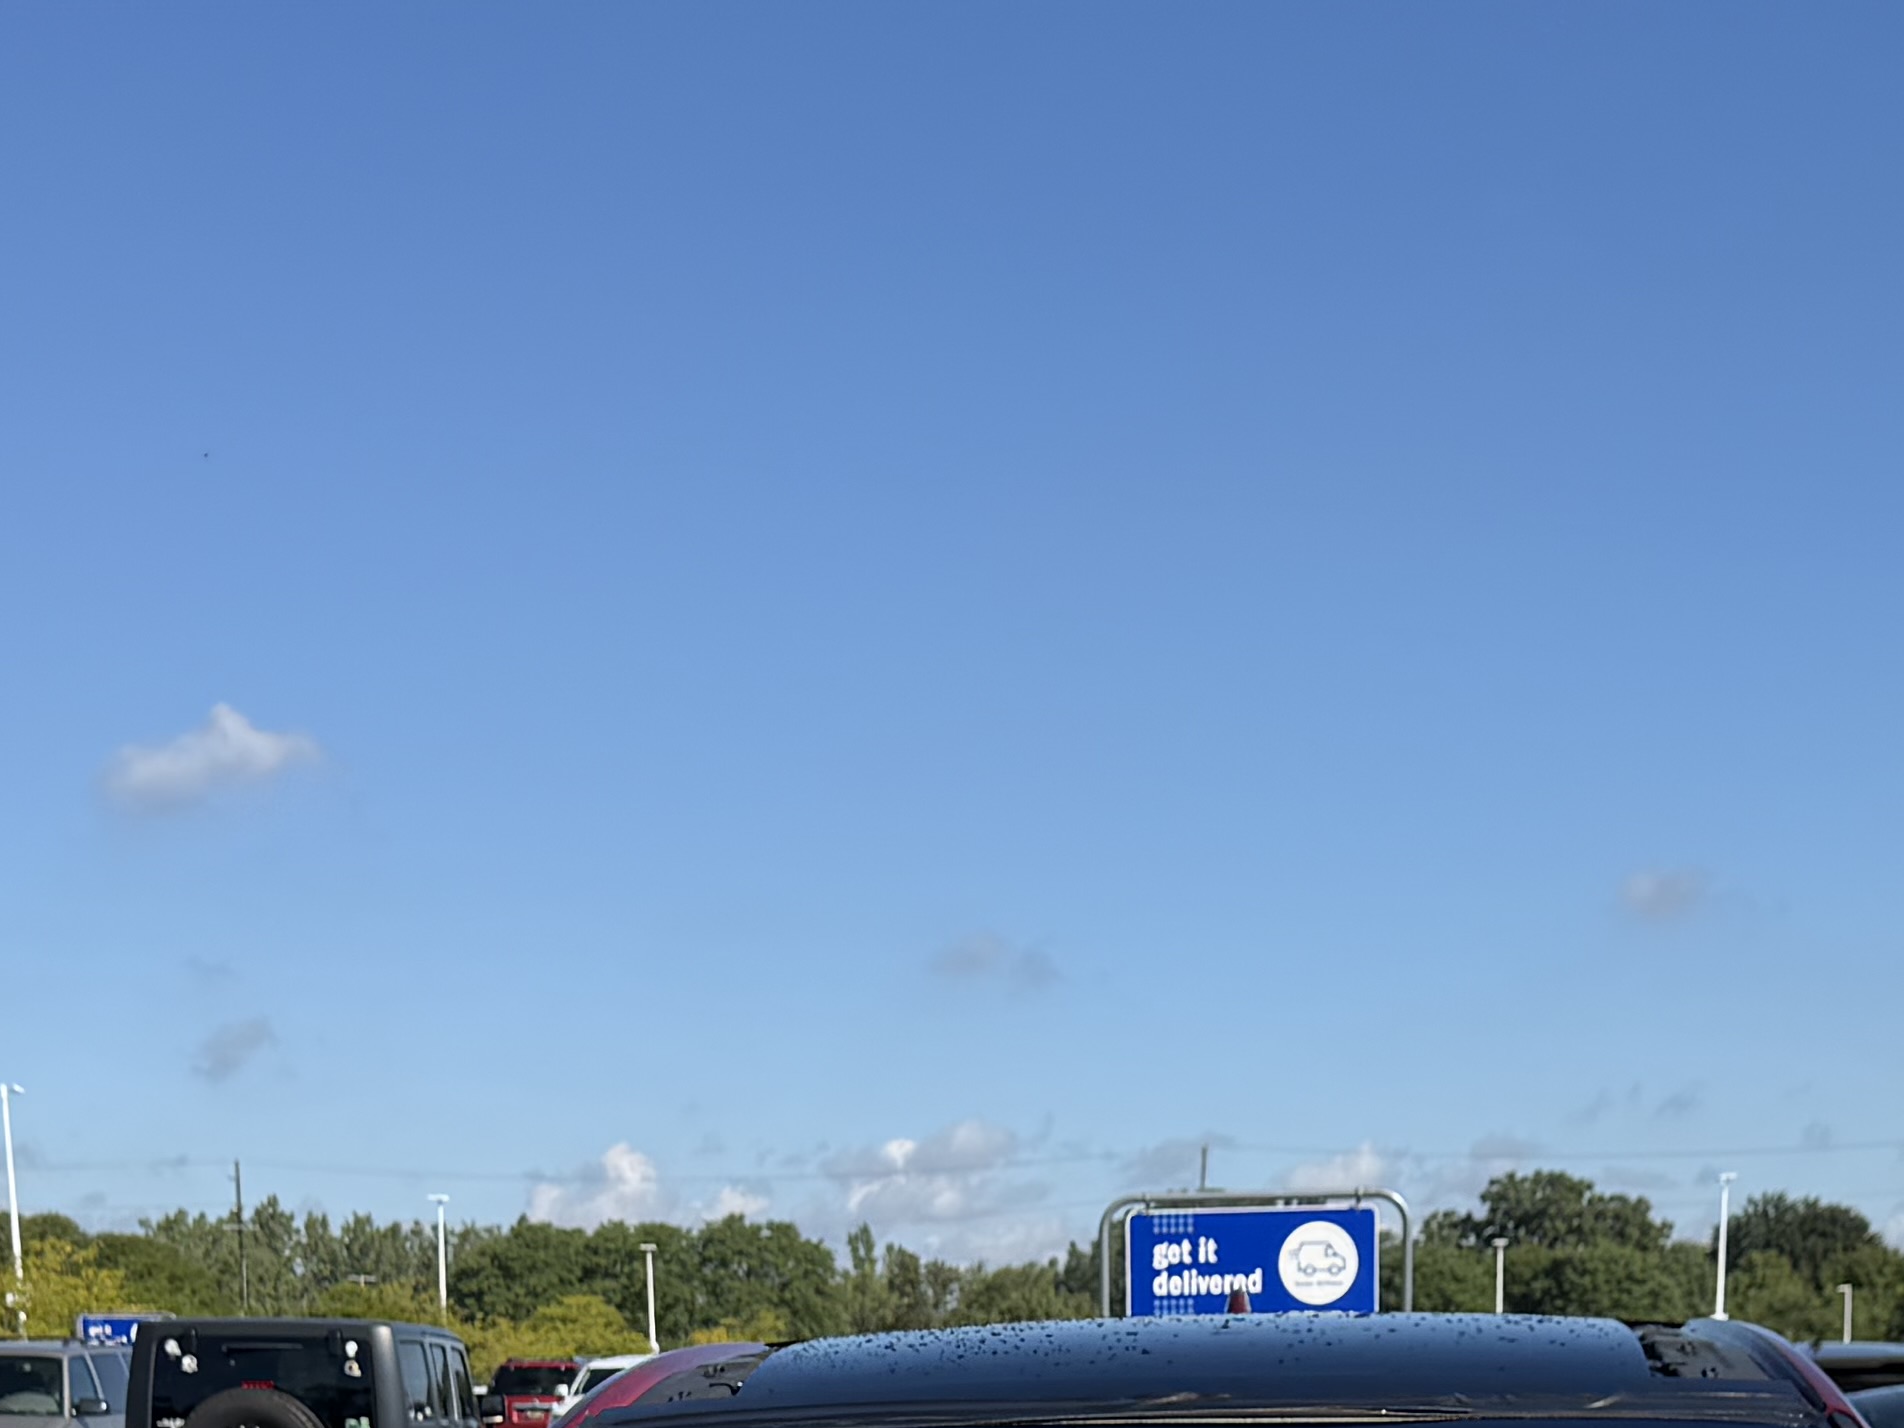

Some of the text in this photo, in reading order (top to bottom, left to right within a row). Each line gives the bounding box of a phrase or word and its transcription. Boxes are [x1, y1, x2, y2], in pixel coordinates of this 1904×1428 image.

[1152, 1236, 1218, 1270] get it
[1152, 1267, 1263, 1297] delivered
